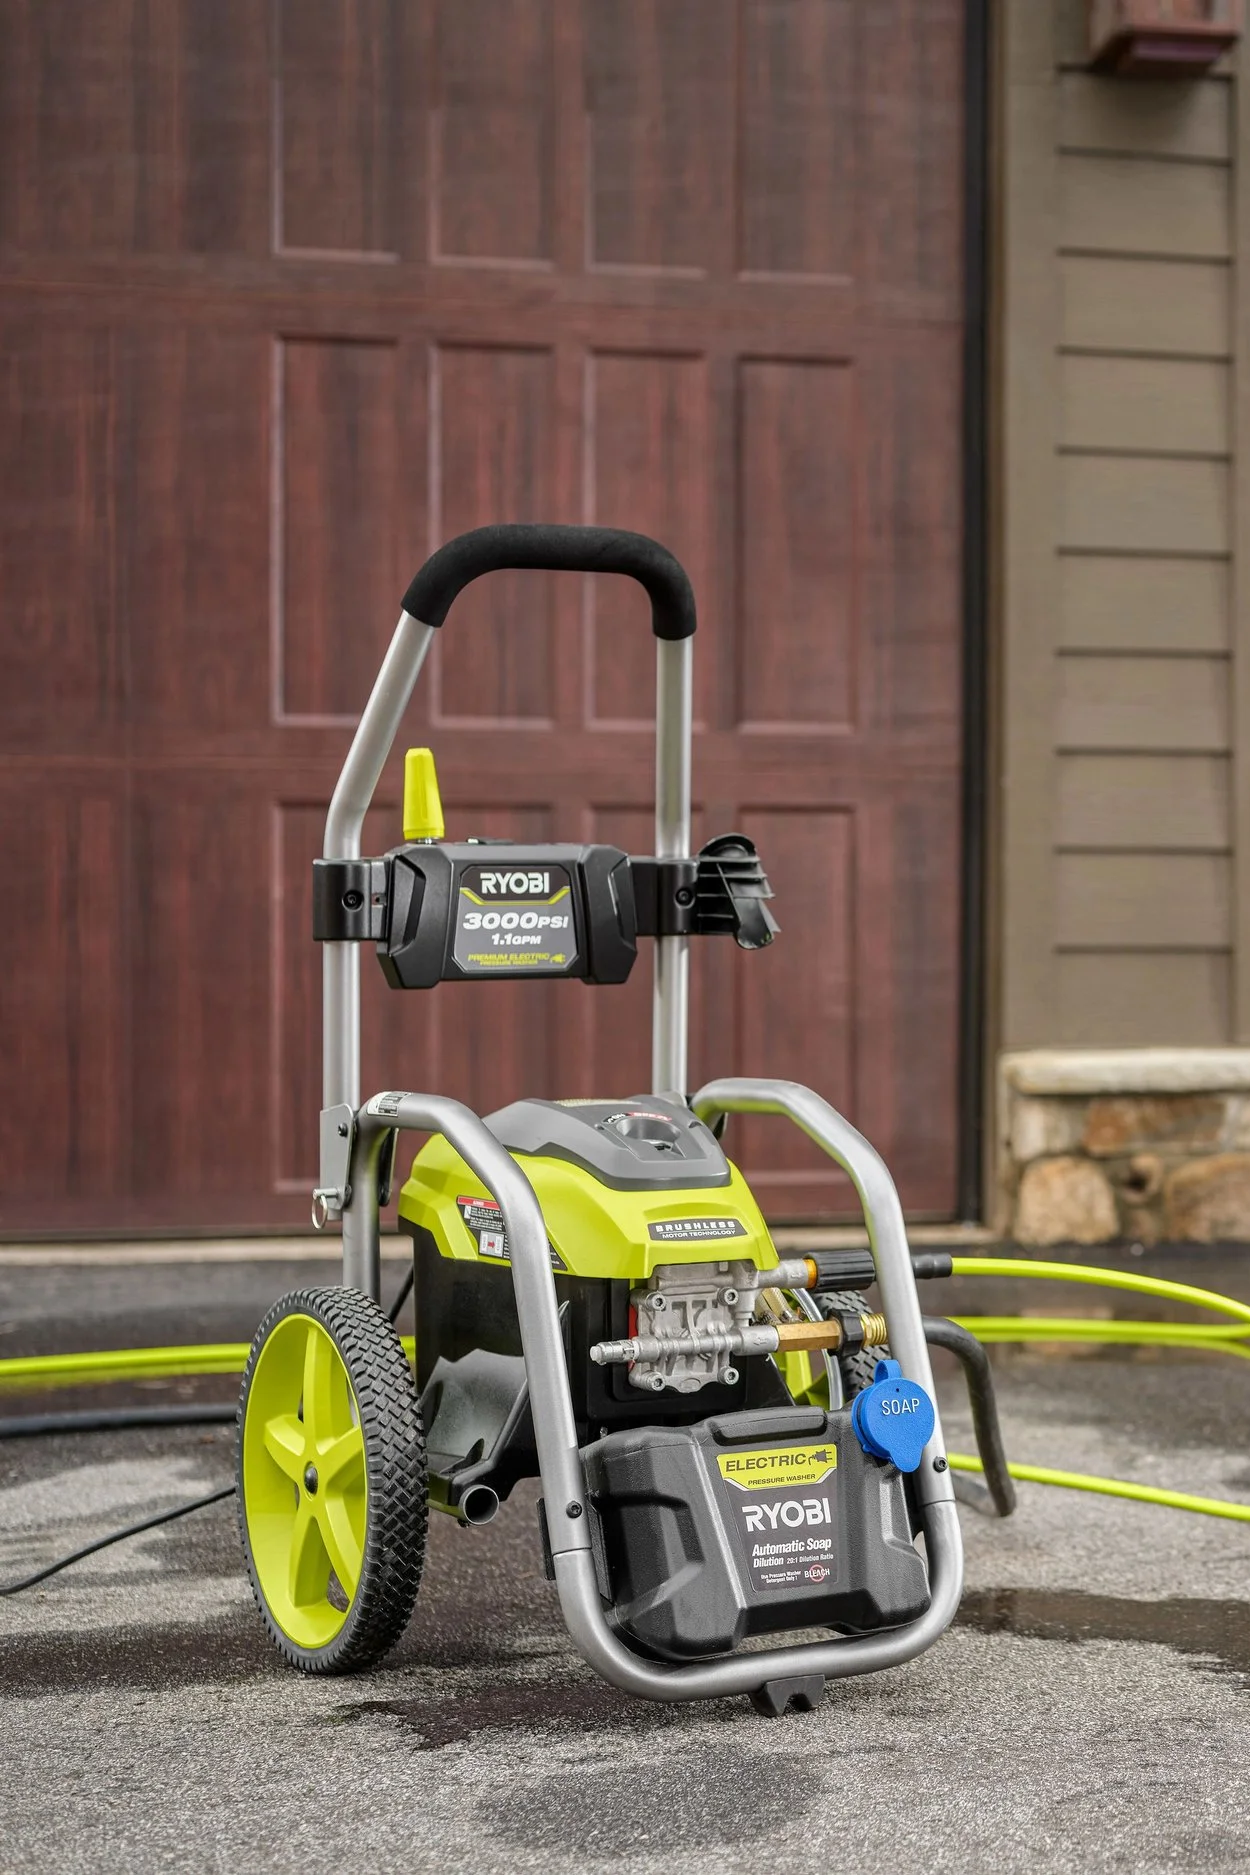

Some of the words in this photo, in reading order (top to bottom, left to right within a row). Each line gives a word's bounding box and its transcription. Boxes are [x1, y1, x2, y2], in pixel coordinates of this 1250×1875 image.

[480, 872, 550, 894] RYOBI
[463, 912, 569, 929] 3000PSI
[492, 933, 541, 945] 1.1GPM
[468, 953, 508, 961] PREMIUM
[510, 952, 550, 961] ELECTRIC
[655, 1221, 735, 1233] BRUSHLESS
[881, 1398, 920, 1416] SOAP
[726, 1453, 807, 1472] ELECTRIC
[748, 1477, 785, 1486] PRESSURE
[786, 1474, 816, 1482] WASHER
[742, 1498, 832, 1532] RYOBI
[752, 1540, 805, 1557] Automatic
[806, 1537, 832, 1551] Soap
[753, 1556, 784, 1568] Dilution
[786, 1557, 798, 1565] 20:1
[799, 1555, 819, 1563] Dilution
[804, 1568, 831, 1578] BLEACH
